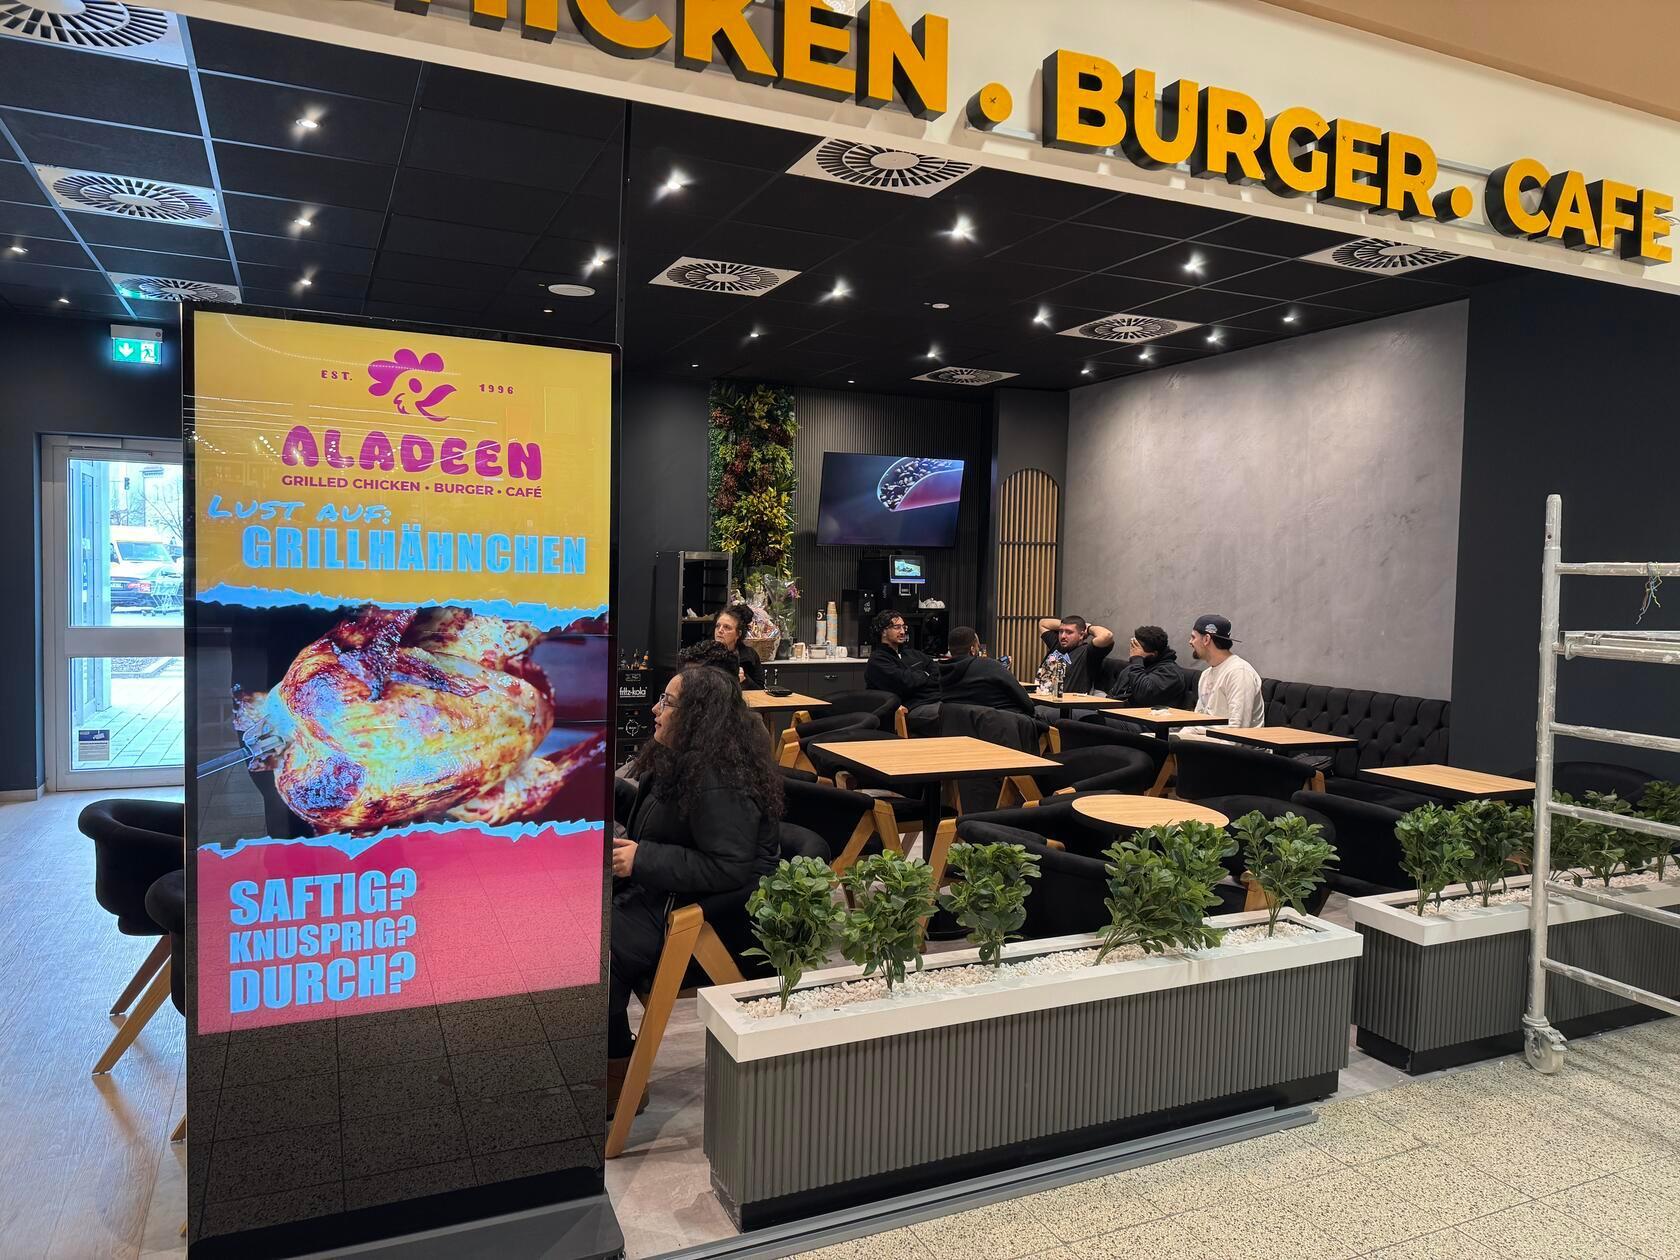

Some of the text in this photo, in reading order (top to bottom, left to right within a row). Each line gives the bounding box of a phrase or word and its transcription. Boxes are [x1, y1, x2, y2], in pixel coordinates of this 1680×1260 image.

[1045, 49, 1437, 221] BURGER
[1488, 158, 1674, 264] CAFE
[321, 369, 514, 395] EST. 1996
[281, 424, 542, 481] ALADEEN
[207, 495, 392, 525] LUST AUF:
[281, 475, 542, 498] GRILLED CHICKEN BURGER CAFÉ
[241, 523, 587, 575] GRILLHÄHNCHEN
[229, 867, 417, 926] SAFTIG?
[229, 914, 417, 965] KNUSPRIG?
[230, 951, 417, 1014] DURCH?
